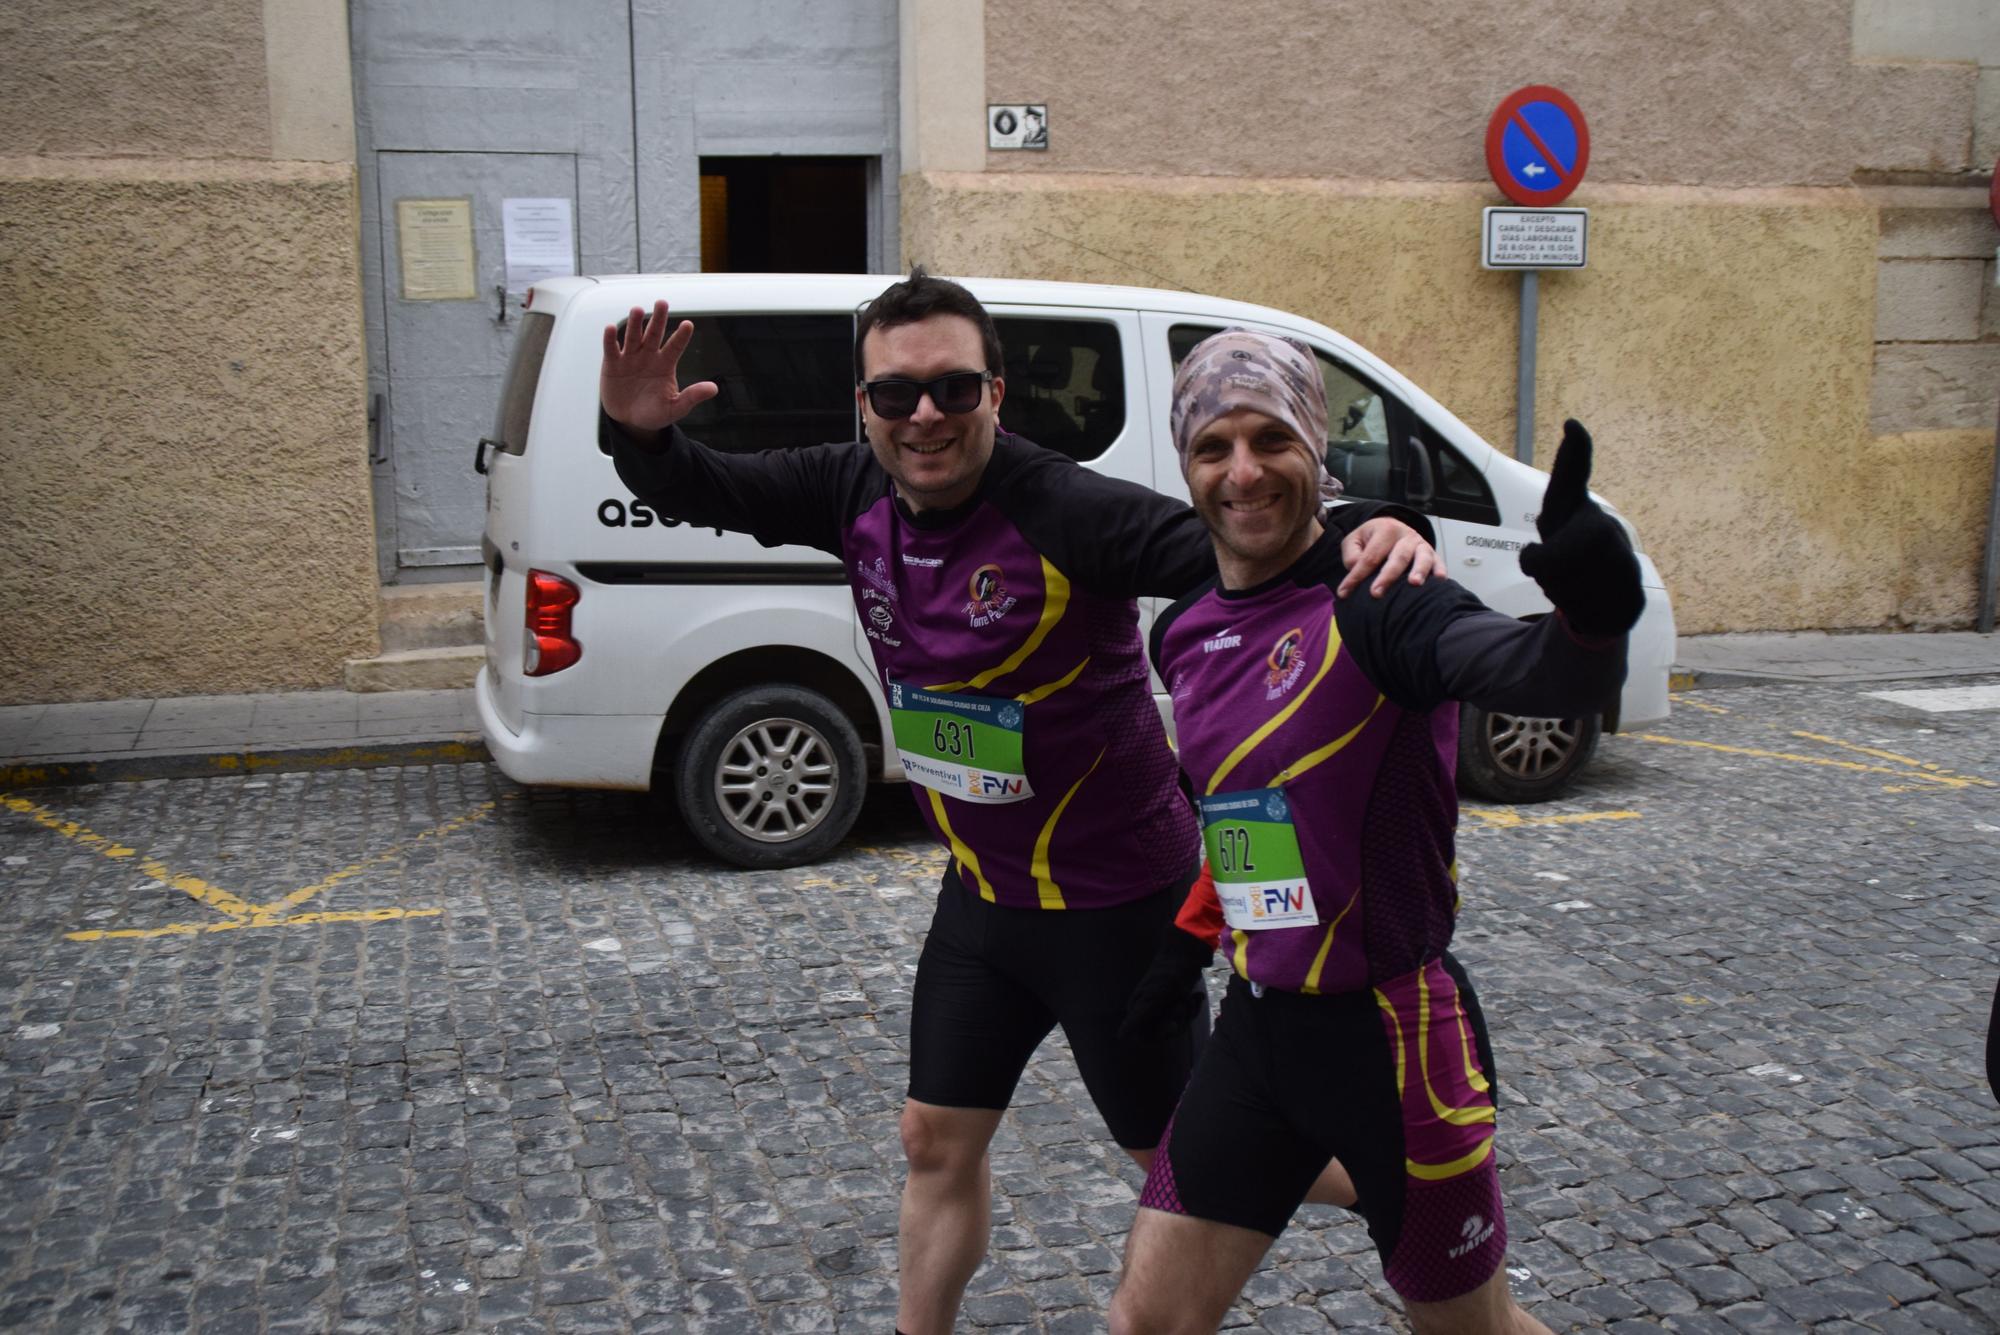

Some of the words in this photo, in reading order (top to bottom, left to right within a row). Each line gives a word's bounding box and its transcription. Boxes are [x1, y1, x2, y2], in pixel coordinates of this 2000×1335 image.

[970, 614, 990, 628] Torre
[1204, 634, 1242, 654] VIATOR
[934, 718, 976, 760] 631
[912, 761, 957, 782] Preventiva
[1218, 828, 1256, 873] 672
[1449, 1221, 1494, 1258] VIATOR
